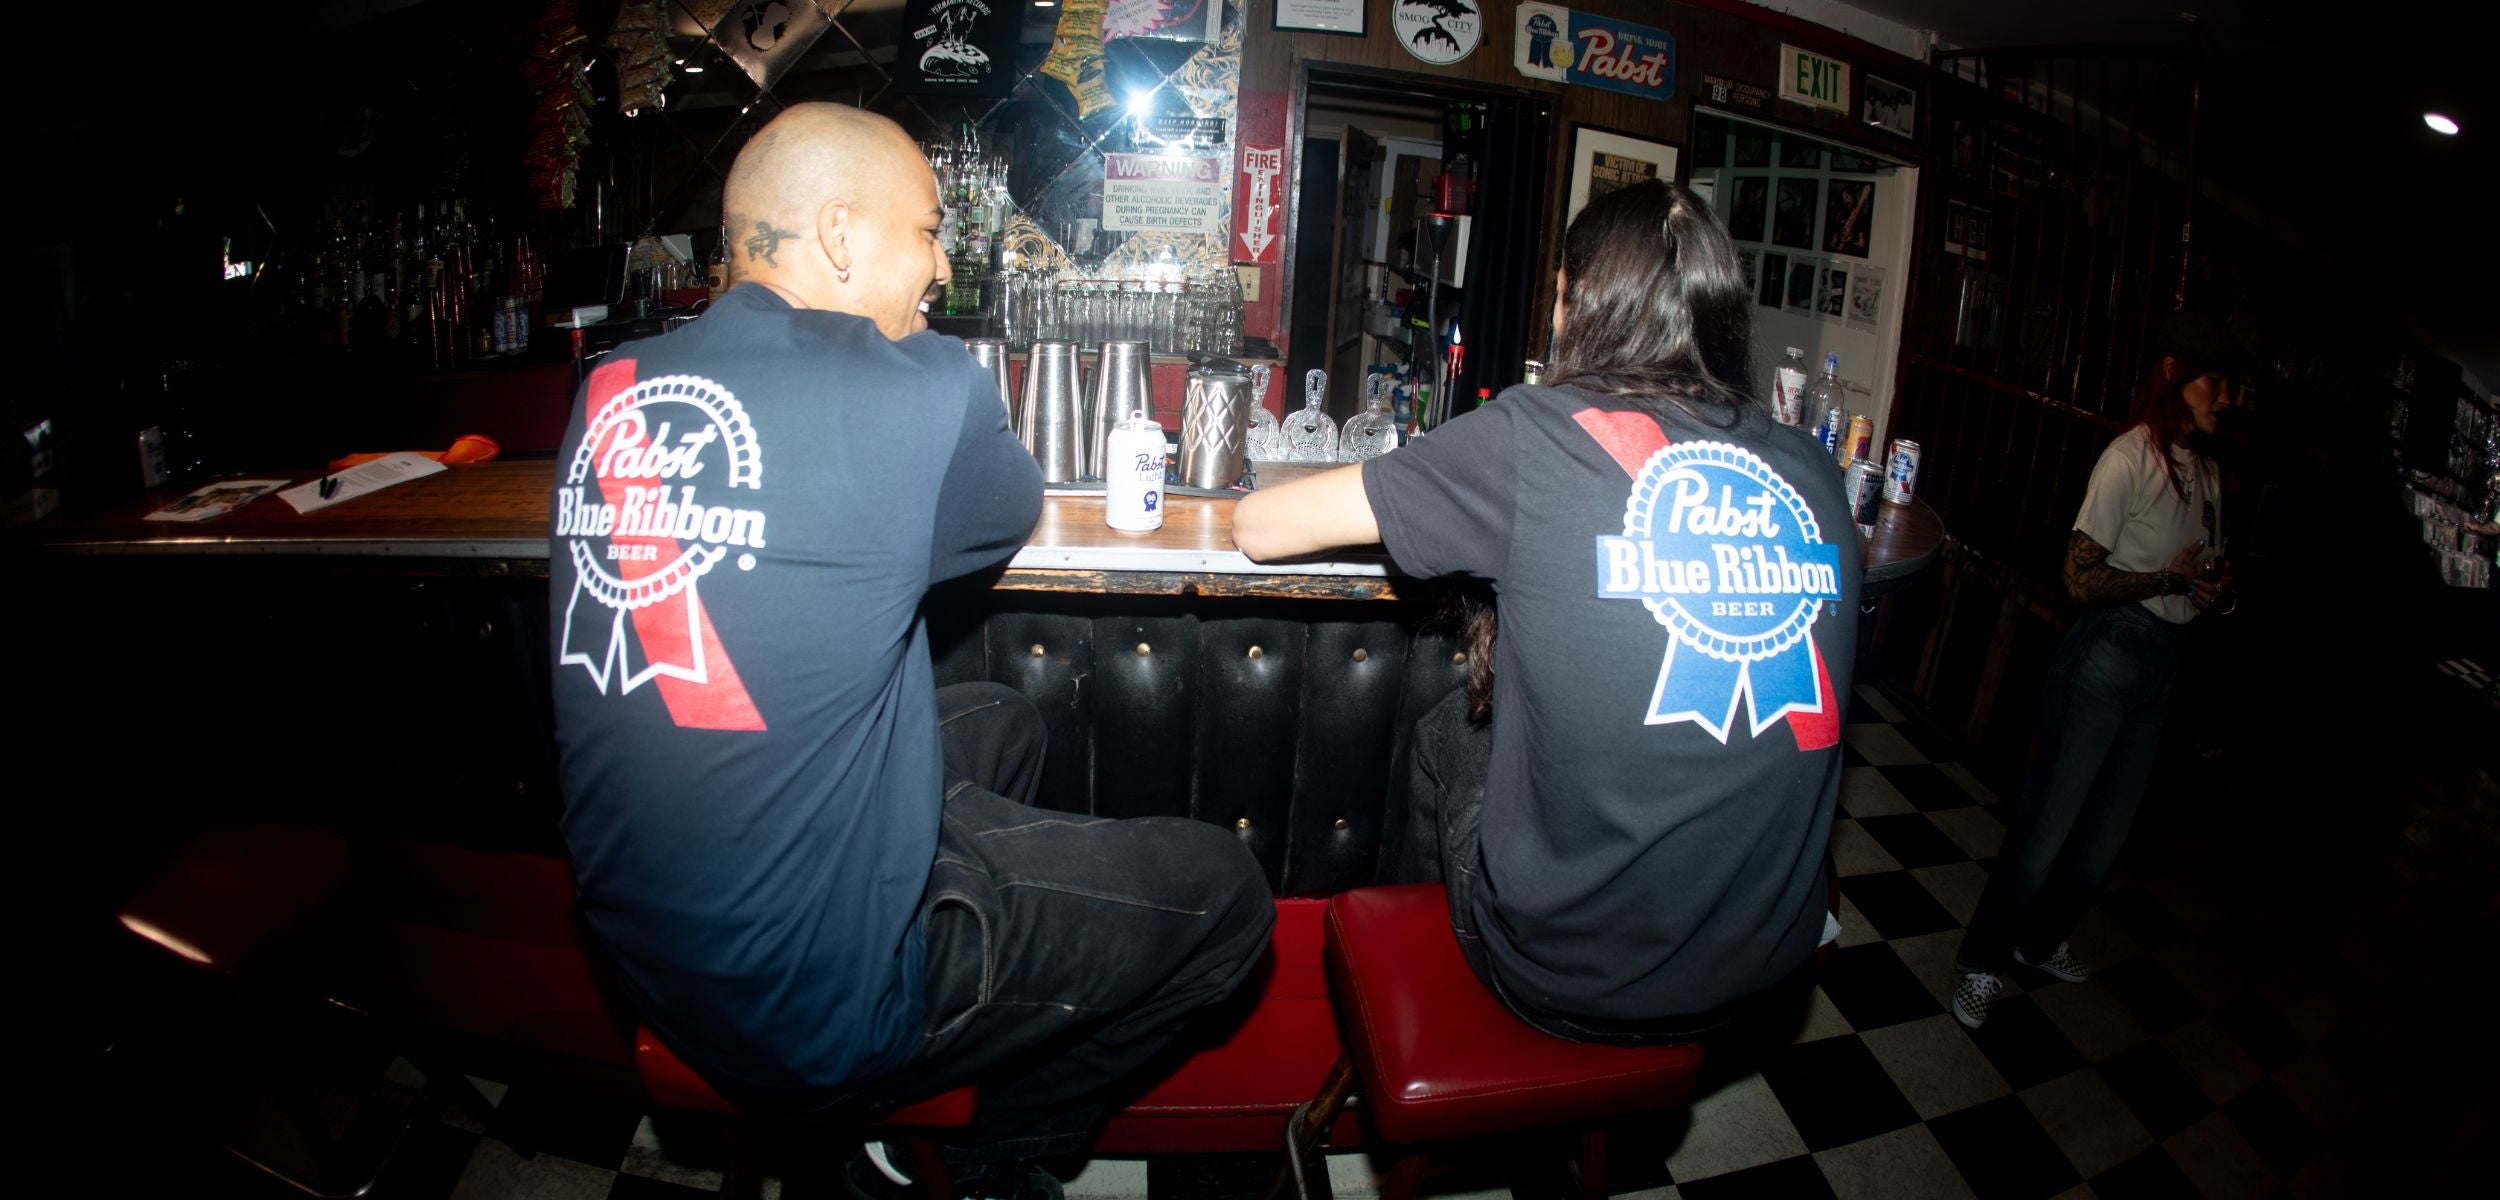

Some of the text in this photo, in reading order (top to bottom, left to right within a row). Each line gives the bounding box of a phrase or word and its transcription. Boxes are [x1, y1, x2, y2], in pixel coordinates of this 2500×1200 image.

[1399, 12, 1473, 31] SMOG CITY
[1617, 31, 1668, 50] DRINK MORE
[1577, 28, 1667, 87] Pabst
[1704, 74, 1771, 100] MAXIMUM OCCUPANCY
[1798, 53, 1841, 103] EXIT
[1714, 86, 1726, 102] 98
[1115, 159, 1212, 179] WARNING
[1246, 153, 1278, 170] FIRE
[1605, 154, 1647, 174] VICTIM OF
[1593, 165, 1620, 182] SONIC
[1113, 184, 1147, 194] DRINKING
[1196, 187, 1211, 195] AND
[1105, 194, 1218, 206] OTHER ALCOHOLIC BEVERAGES
[1115, 205, 1207, 216] DURING PREGNANCY CAN
[1252, 169, 1265, 254] EXTINGUISHER
[1119, 215, 1202, 226] CAUSE BIRTH DEFECTS
[1826, 408, 1840, 455] smart
[598, 409, 718, 480] Pabst
[1135, 453, 1164, 472] Pabst
[1660, 468, 1780, 538] Pabst
[556, 485, 767, 549] Blue Ribbon
[606, 544, 659, 561] BEER
[1605, 539, 1838, 596] Blue Ribbon
[1712, 602, 1775, 617] BEER
